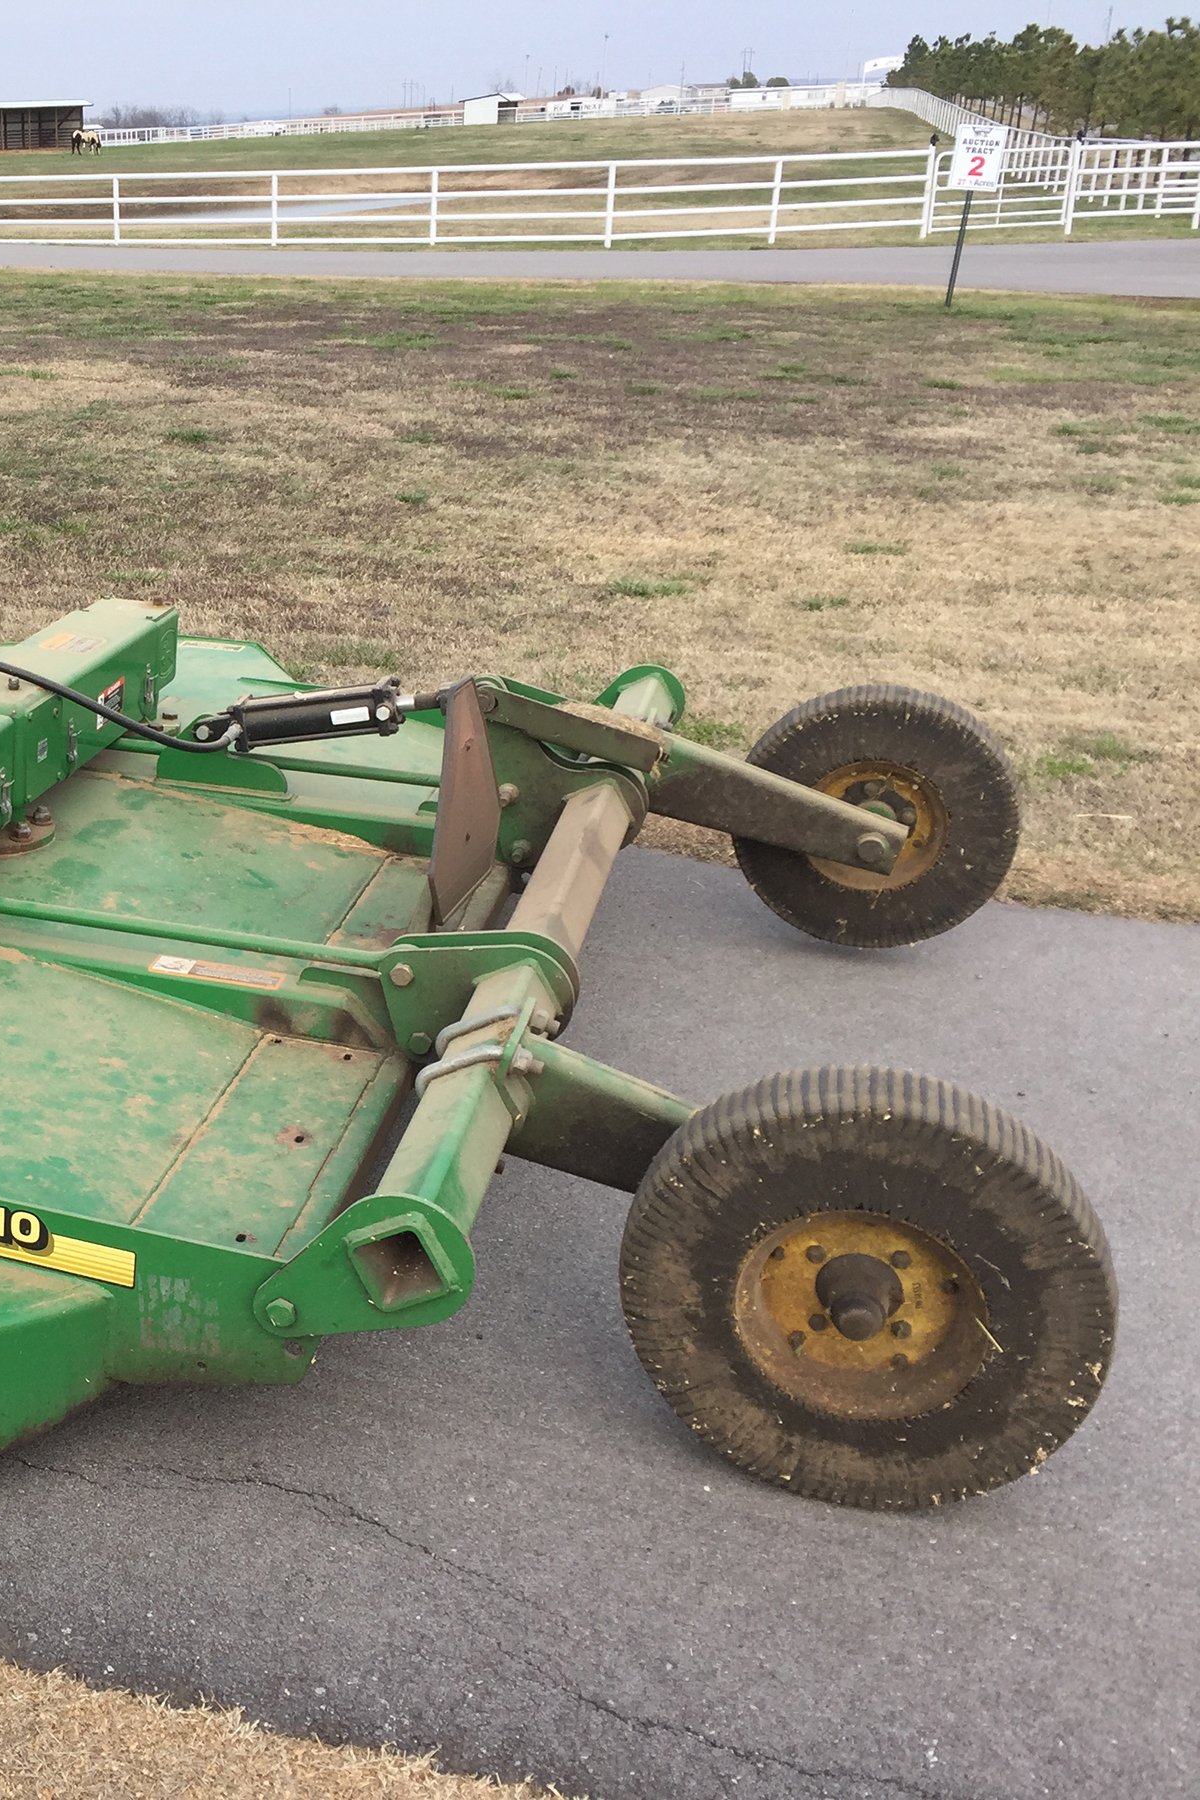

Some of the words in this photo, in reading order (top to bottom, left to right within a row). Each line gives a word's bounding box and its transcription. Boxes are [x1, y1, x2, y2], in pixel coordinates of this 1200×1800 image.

[962, 138, 1000, 147] AUCTION
[965, 146, 995, 155] TRACT
[967, 156, 986, 177] 2
